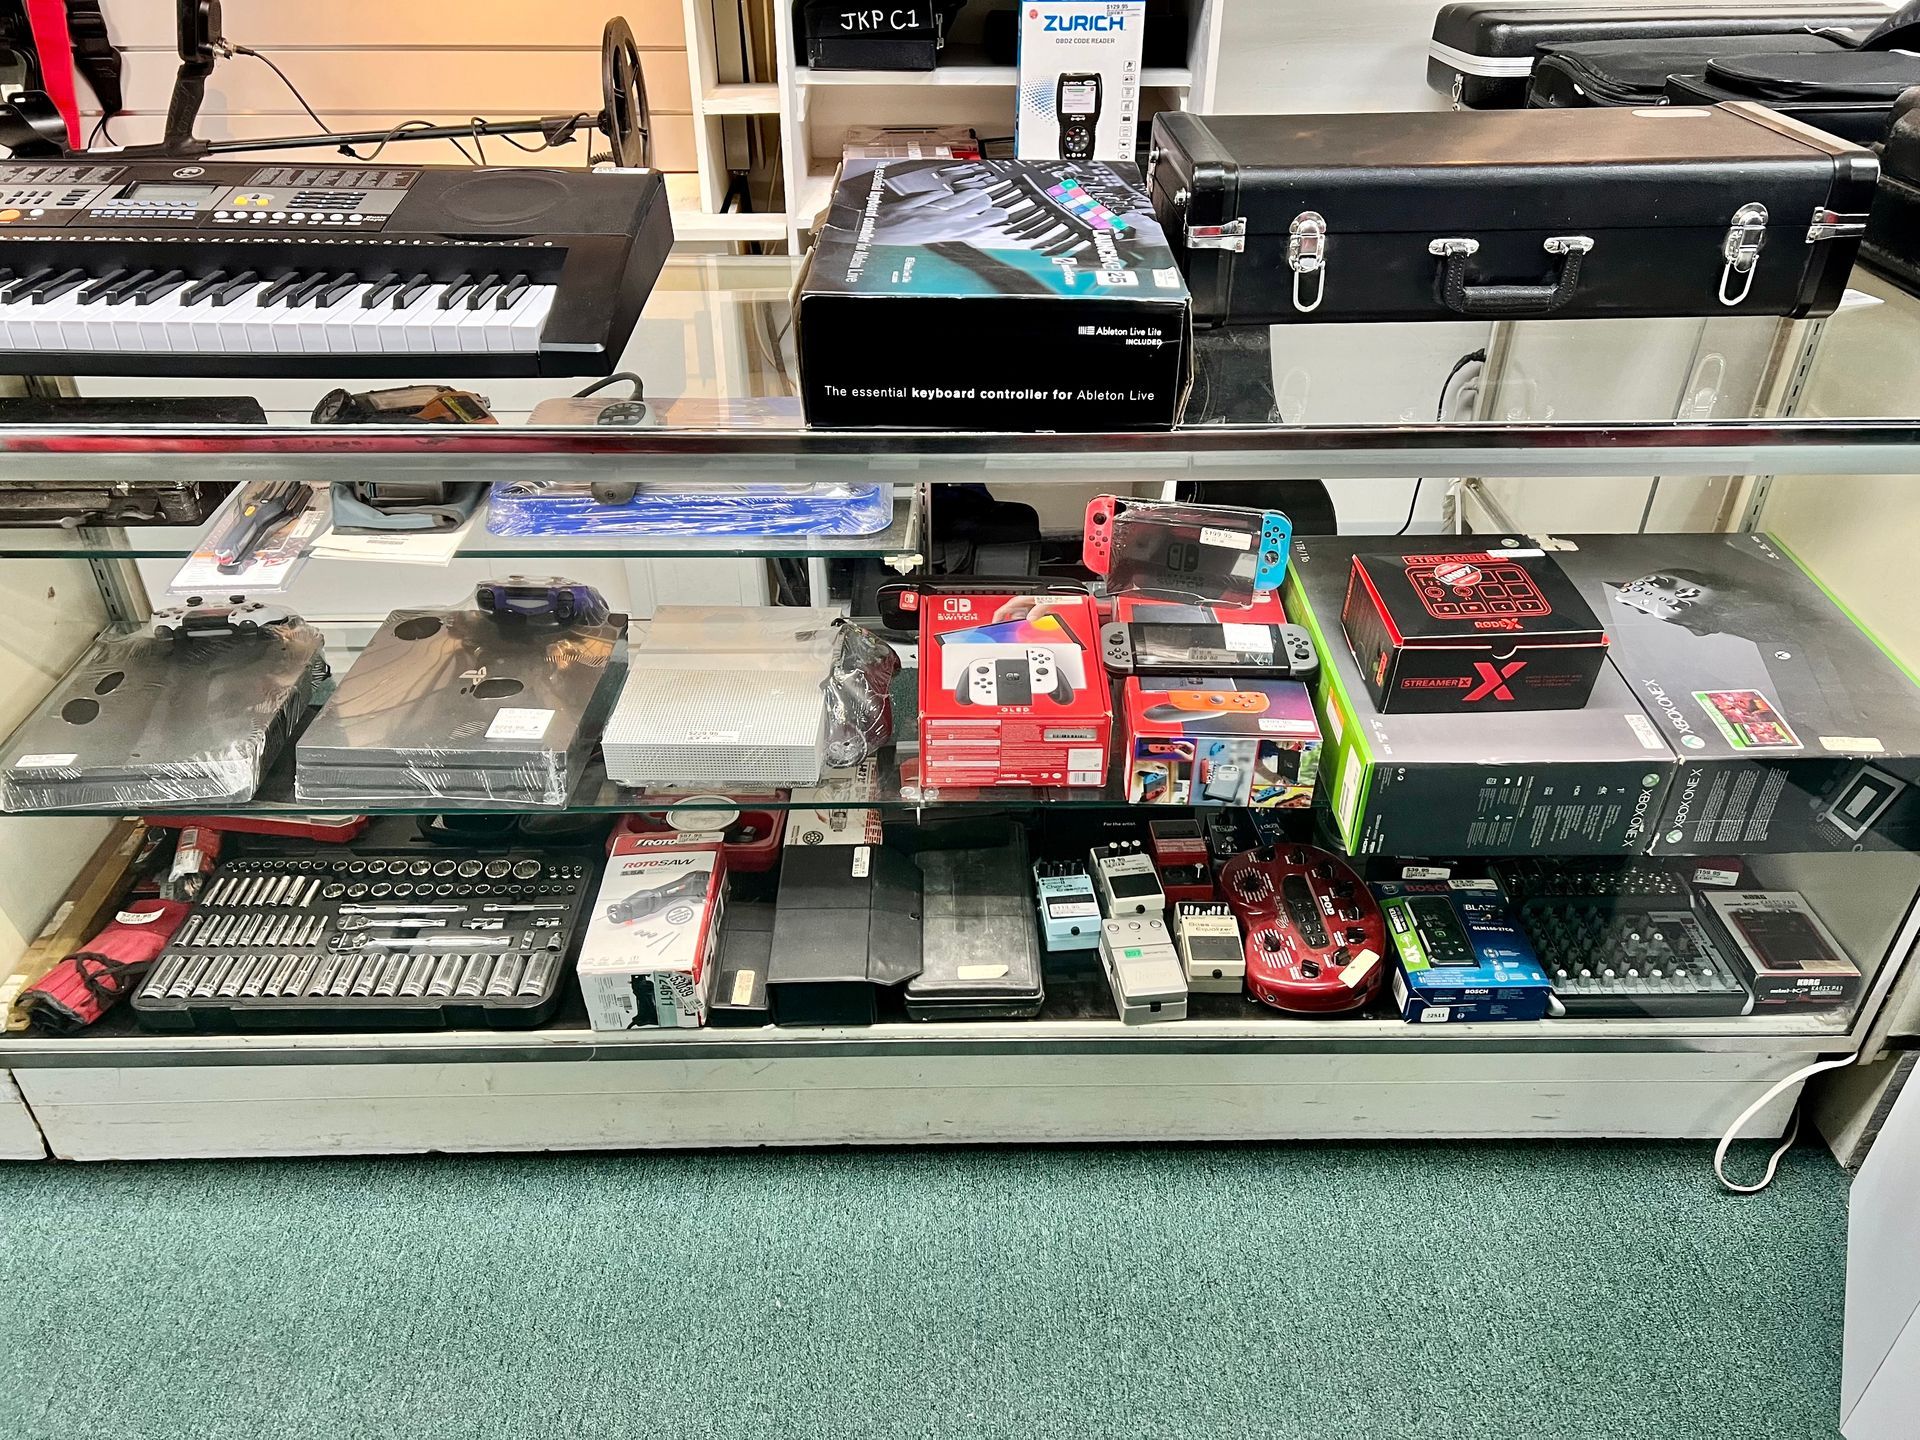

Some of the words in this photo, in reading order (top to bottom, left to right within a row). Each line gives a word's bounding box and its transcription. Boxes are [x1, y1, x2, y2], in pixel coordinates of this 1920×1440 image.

[841, 9, 884, 30] JKP
[890, 9, 920, 30] C1
[1043, 15, 1124, 31] ZURICH
[845, 269, 864, 282] Live
[1108, 272, 1127, 283] 25
[1096, 326, 1128, 336] Ableton
[1130, 326, 1146, 336] Live
[1147, 327, 1162, 336] Lite
[825, 385, 847, 397] The
[852, 387, 907, 398] essential
[911, 388, 975, 402] keyboard
[980, 388, 1048, 400] controller
[1053, 389, 1073, 400] for
[1076, 390, 1125, 401] Ableton
[1129, 390, 1155, 401] Live
[1407, 553, 1487, 561] STREAMER
[1403, 679, 1458, 687] STREAMER
[1462, 662, 1528, 701] X
[1642, 679, 1659, 687] X
[1648, 687, 1673, 708] ONE
[1663, 707, 1694, 734] XBOX
[1690, 768, 1703, 776] X
[1682, 777, 1700, 800] ONE
[1634, 789, 1653, 817] XBOX
[1673, 800, 1692, 829] XBOX
[1625, 817, 1642, 838] ONE
[1622, 839, 1634, 847] X
[623, 858, 696, 869] ROTOSAW
[1321, 895, 1336, 916] POD
[658, 974, 674, 1006] 724611
[670, 975, 694, 997] 53039
